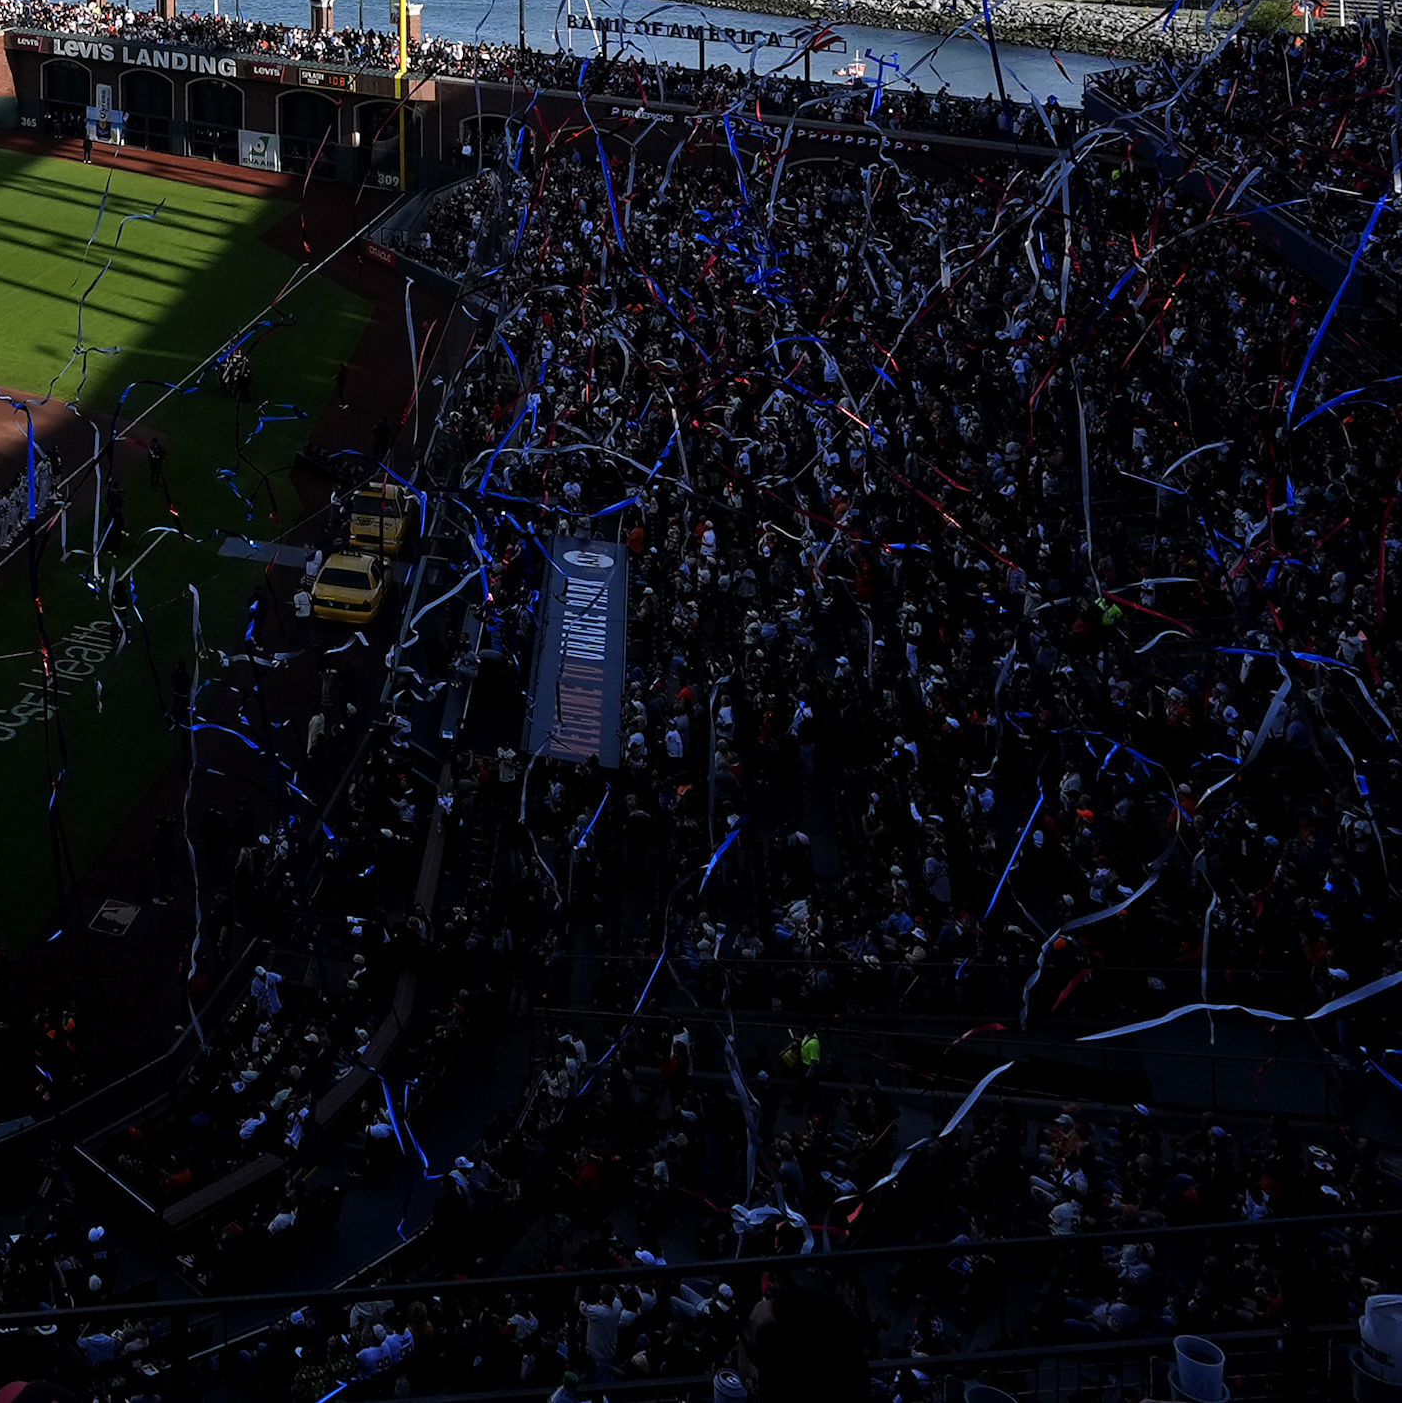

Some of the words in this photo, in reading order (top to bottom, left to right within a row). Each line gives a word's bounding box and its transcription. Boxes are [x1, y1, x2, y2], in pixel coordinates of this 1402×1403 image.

[668, 23, 783, 47] AMERICA
[122, 47, 237, 77] LANDING
[301, 71, 324, 80] SPLASH
[21, 117, 37, 127] 365
[378, 174, 400, 186] 309
[564, 577, 608, 610] PARK
[559, 610, 607, 661] ORACLE
[19, 620, 113, 697] Health
[557, 663, 604, 682] TO
[551, 683, 603, 756] WELCOME
